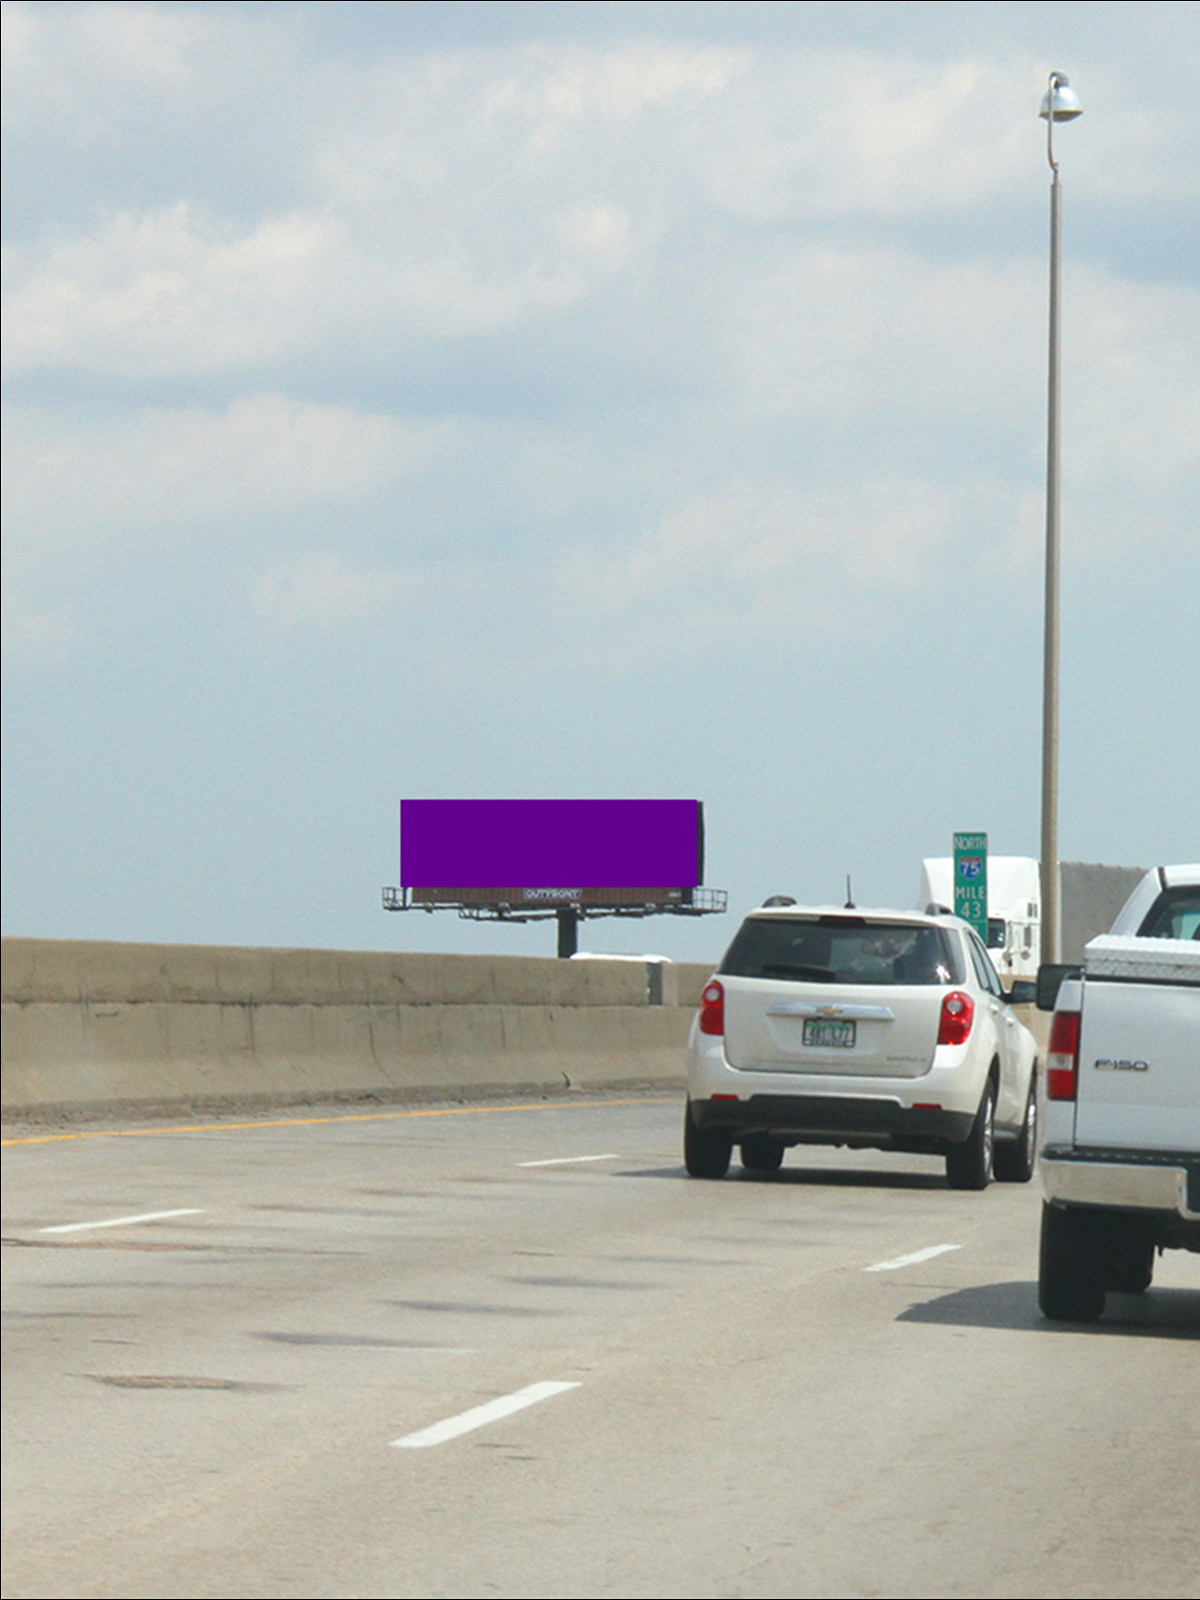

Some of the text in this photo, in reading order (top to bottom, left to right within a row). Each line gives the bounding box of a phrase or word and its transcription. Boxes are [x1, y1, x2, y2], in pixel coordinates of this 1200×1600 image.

[954, 836, 987, 850] NORTH
[963, 862, 980, 875] 75
[956, 886, 985, 899] MILE
[961, 901, 981, 918] 43
